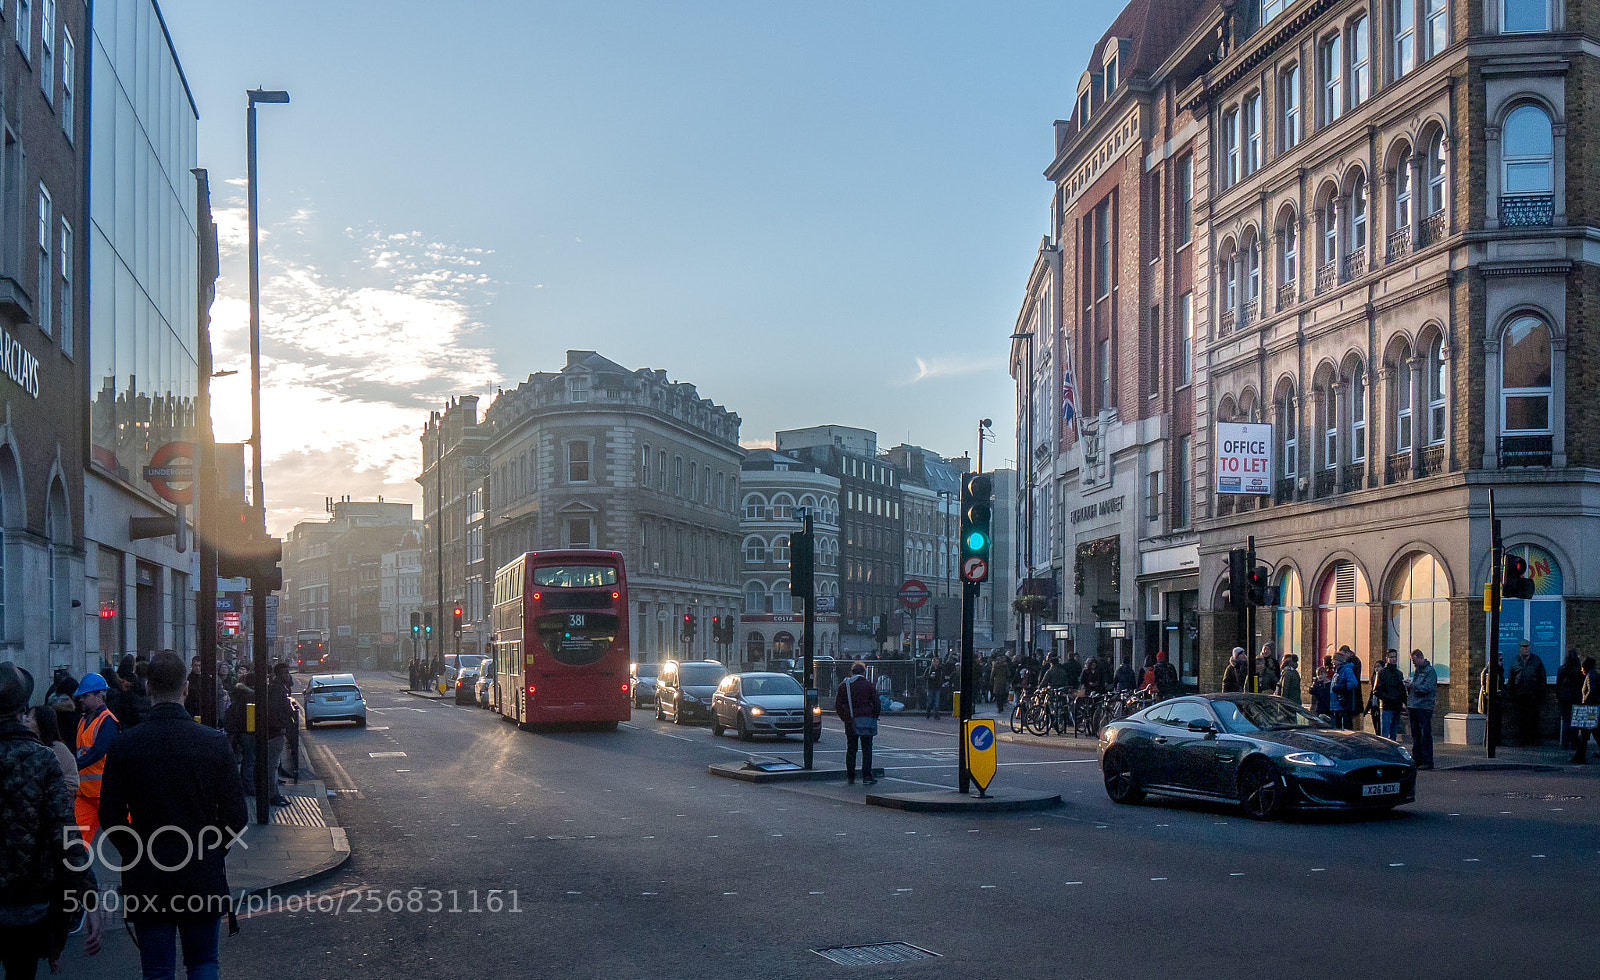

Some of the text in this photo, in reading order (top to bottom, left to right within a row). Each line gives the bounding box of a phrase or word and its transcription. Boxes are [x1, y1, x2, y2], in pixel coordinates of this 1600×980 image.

[1224, 440, 1265, 454] OFFICE
[1220, 457, 1268, 473] TO LET
[569, 614, 585, 626] 381
